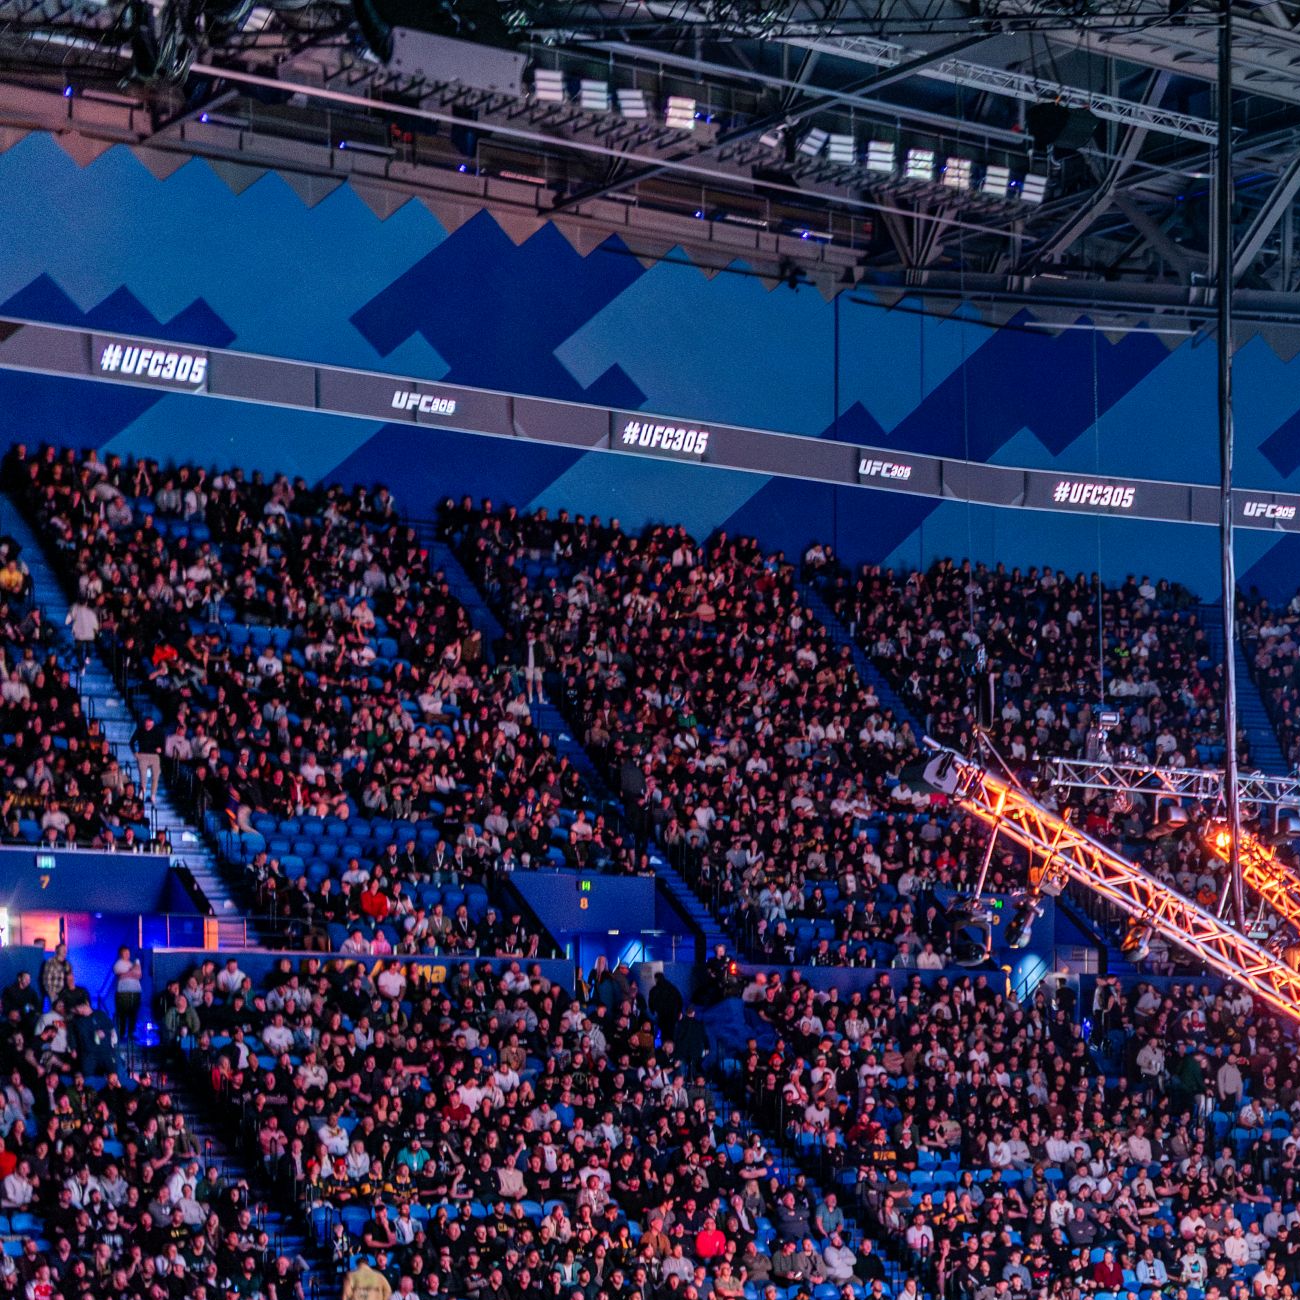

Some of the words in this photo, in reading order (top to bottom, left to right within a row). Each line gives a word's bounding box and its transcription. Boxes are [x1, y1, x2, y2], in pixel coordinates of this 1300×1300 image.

[101, 344, 207, 383] #UFC305
[622, 421, 708, 455] #UFC305
[1053, 481, 1135, 507] #UFC305
[40, 875, 50, 890] 7
[580, 897, 588, 910] 8
